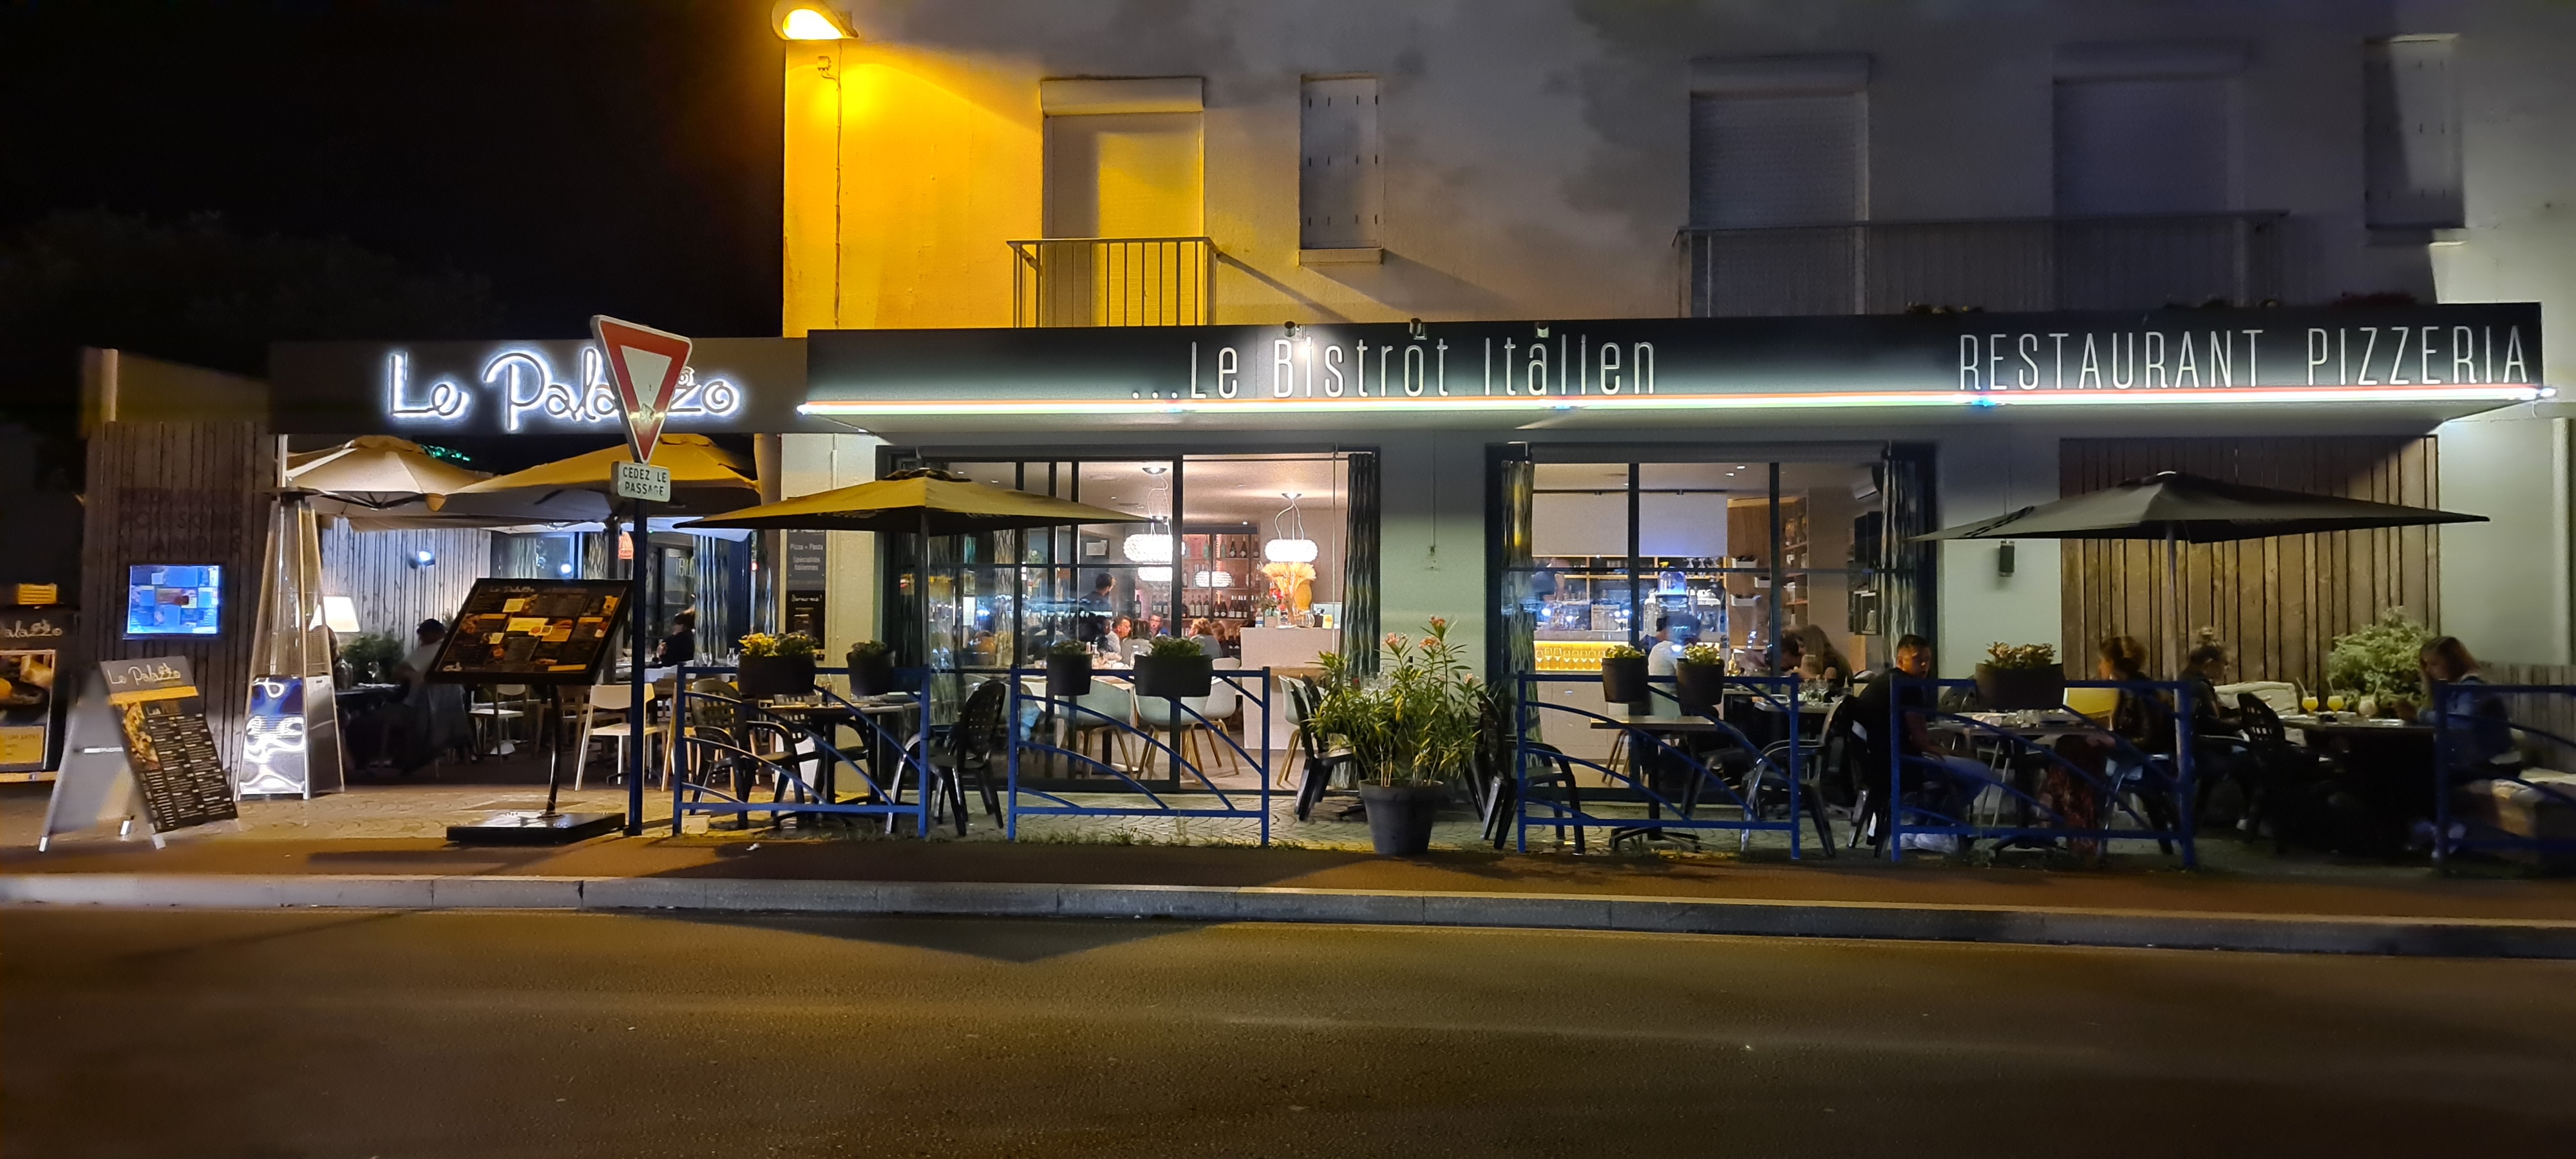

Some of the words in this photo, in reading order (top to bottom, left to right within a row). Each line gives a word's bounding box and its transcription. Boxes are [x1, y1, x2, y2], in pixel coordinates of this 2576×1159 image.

[1273, 335, 1449, 398] Bistrot
[1484, 333, 1654, 395] Italien
[1958, 329, 2264, 391] RESTAURANT
[2307, 325, 2529, 386] PIZZERIA
[389, 350, 469, 419] Le
[482, 347, 738, 431] Palazo
[656, 471, 667, 483] LE
[0, 619, 63, 639] alazzo
[107, 669, 127, 684] Le
[128, 662, 181, 686] Palazzo
